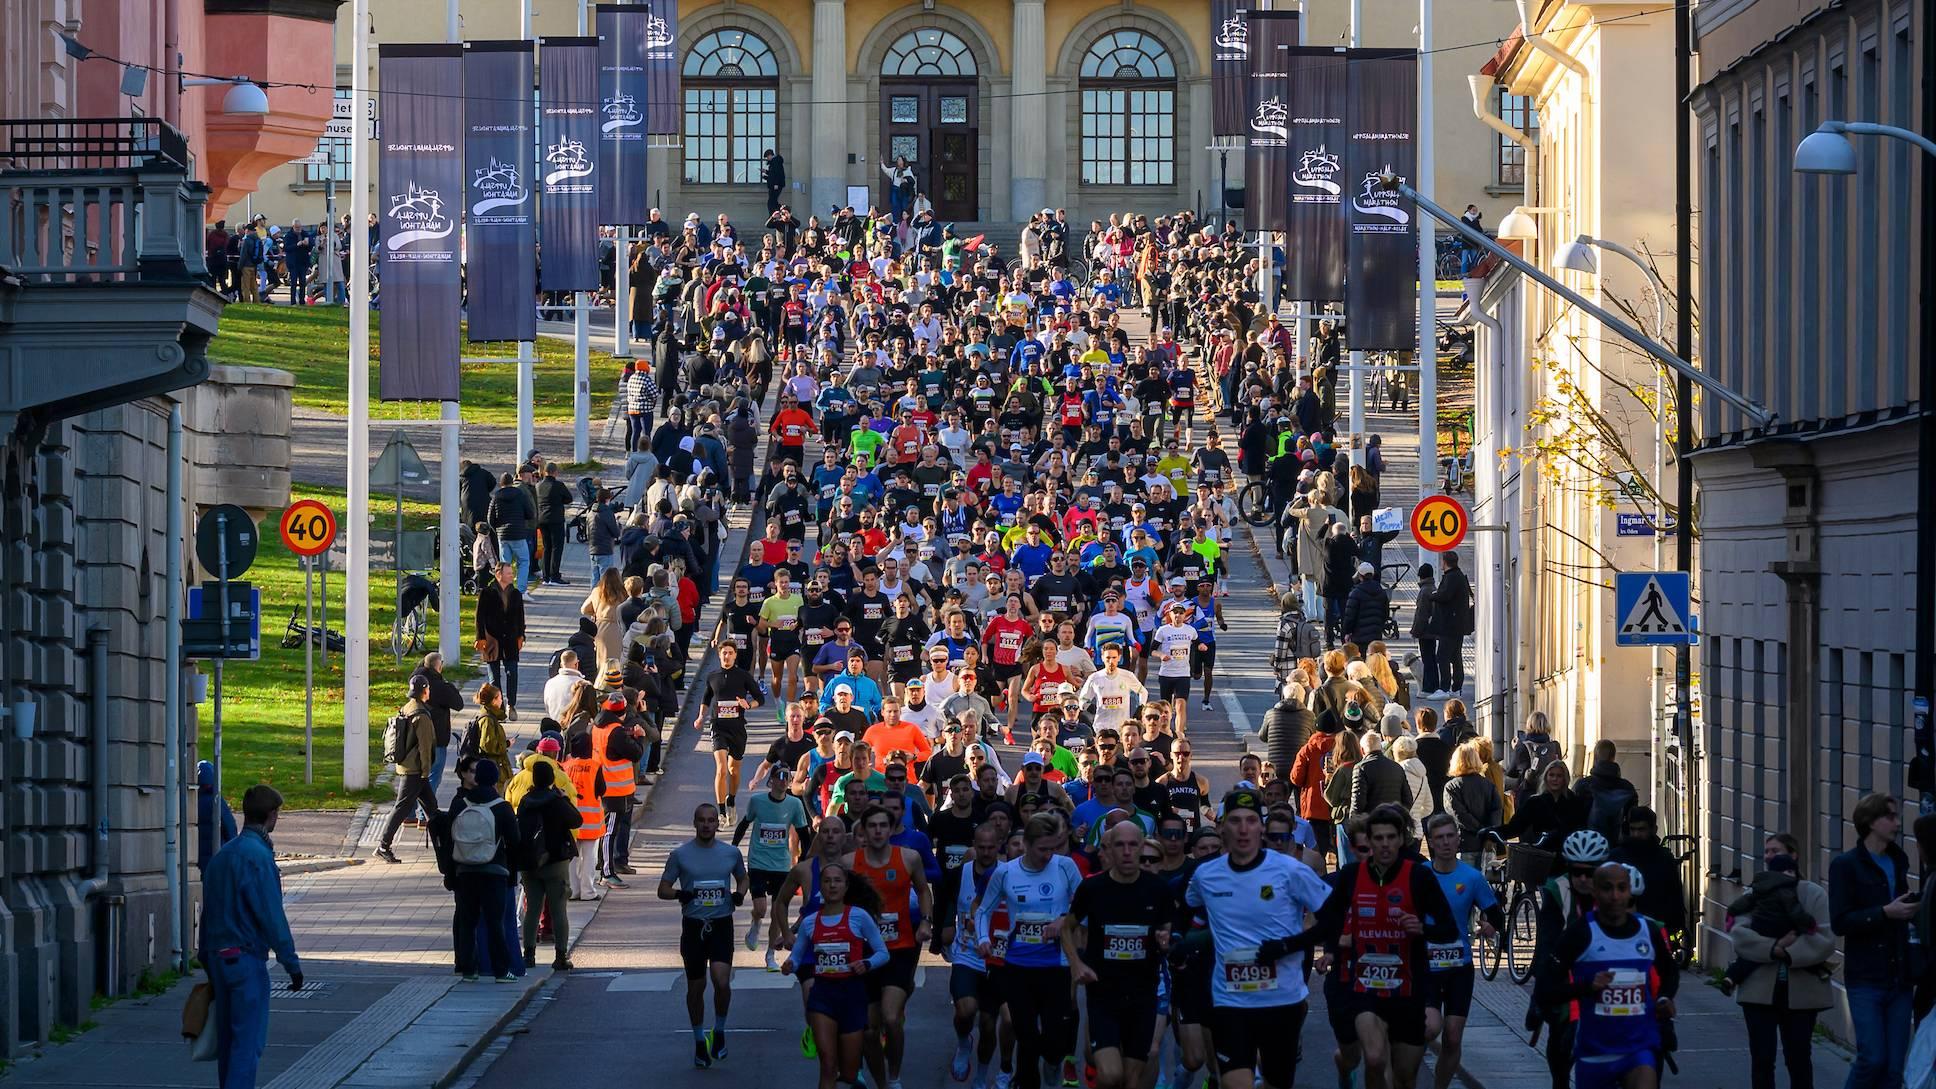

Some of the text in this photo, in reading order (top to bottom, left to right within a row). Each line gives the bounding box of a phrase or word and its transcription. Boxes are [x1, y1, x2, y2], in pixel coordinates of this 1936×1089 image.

[1362, 199, 1399, 207] MARATHON
[1420, 510, 1459, 537] 40
[1620, 516, 1645, 526] Ingmar
[289, 514, 327, 541] 40
[1103, 697, 1122, 705] 4886
[763, 830, 784, 840] 5951
[697, 889, 723, 900] 5339
[1359, 929, 1407, 939] ALEWALDS
[1109, 938, 1144, 951] 5966
[818, 954, 847, 966] 6495
[1432, 950, 1461, 960] 5379
[1230, 966, 1271, 982] 6499
[1363, 965, 1399, 979] 4207
[1601, 988, 1643, 1005] 6516
